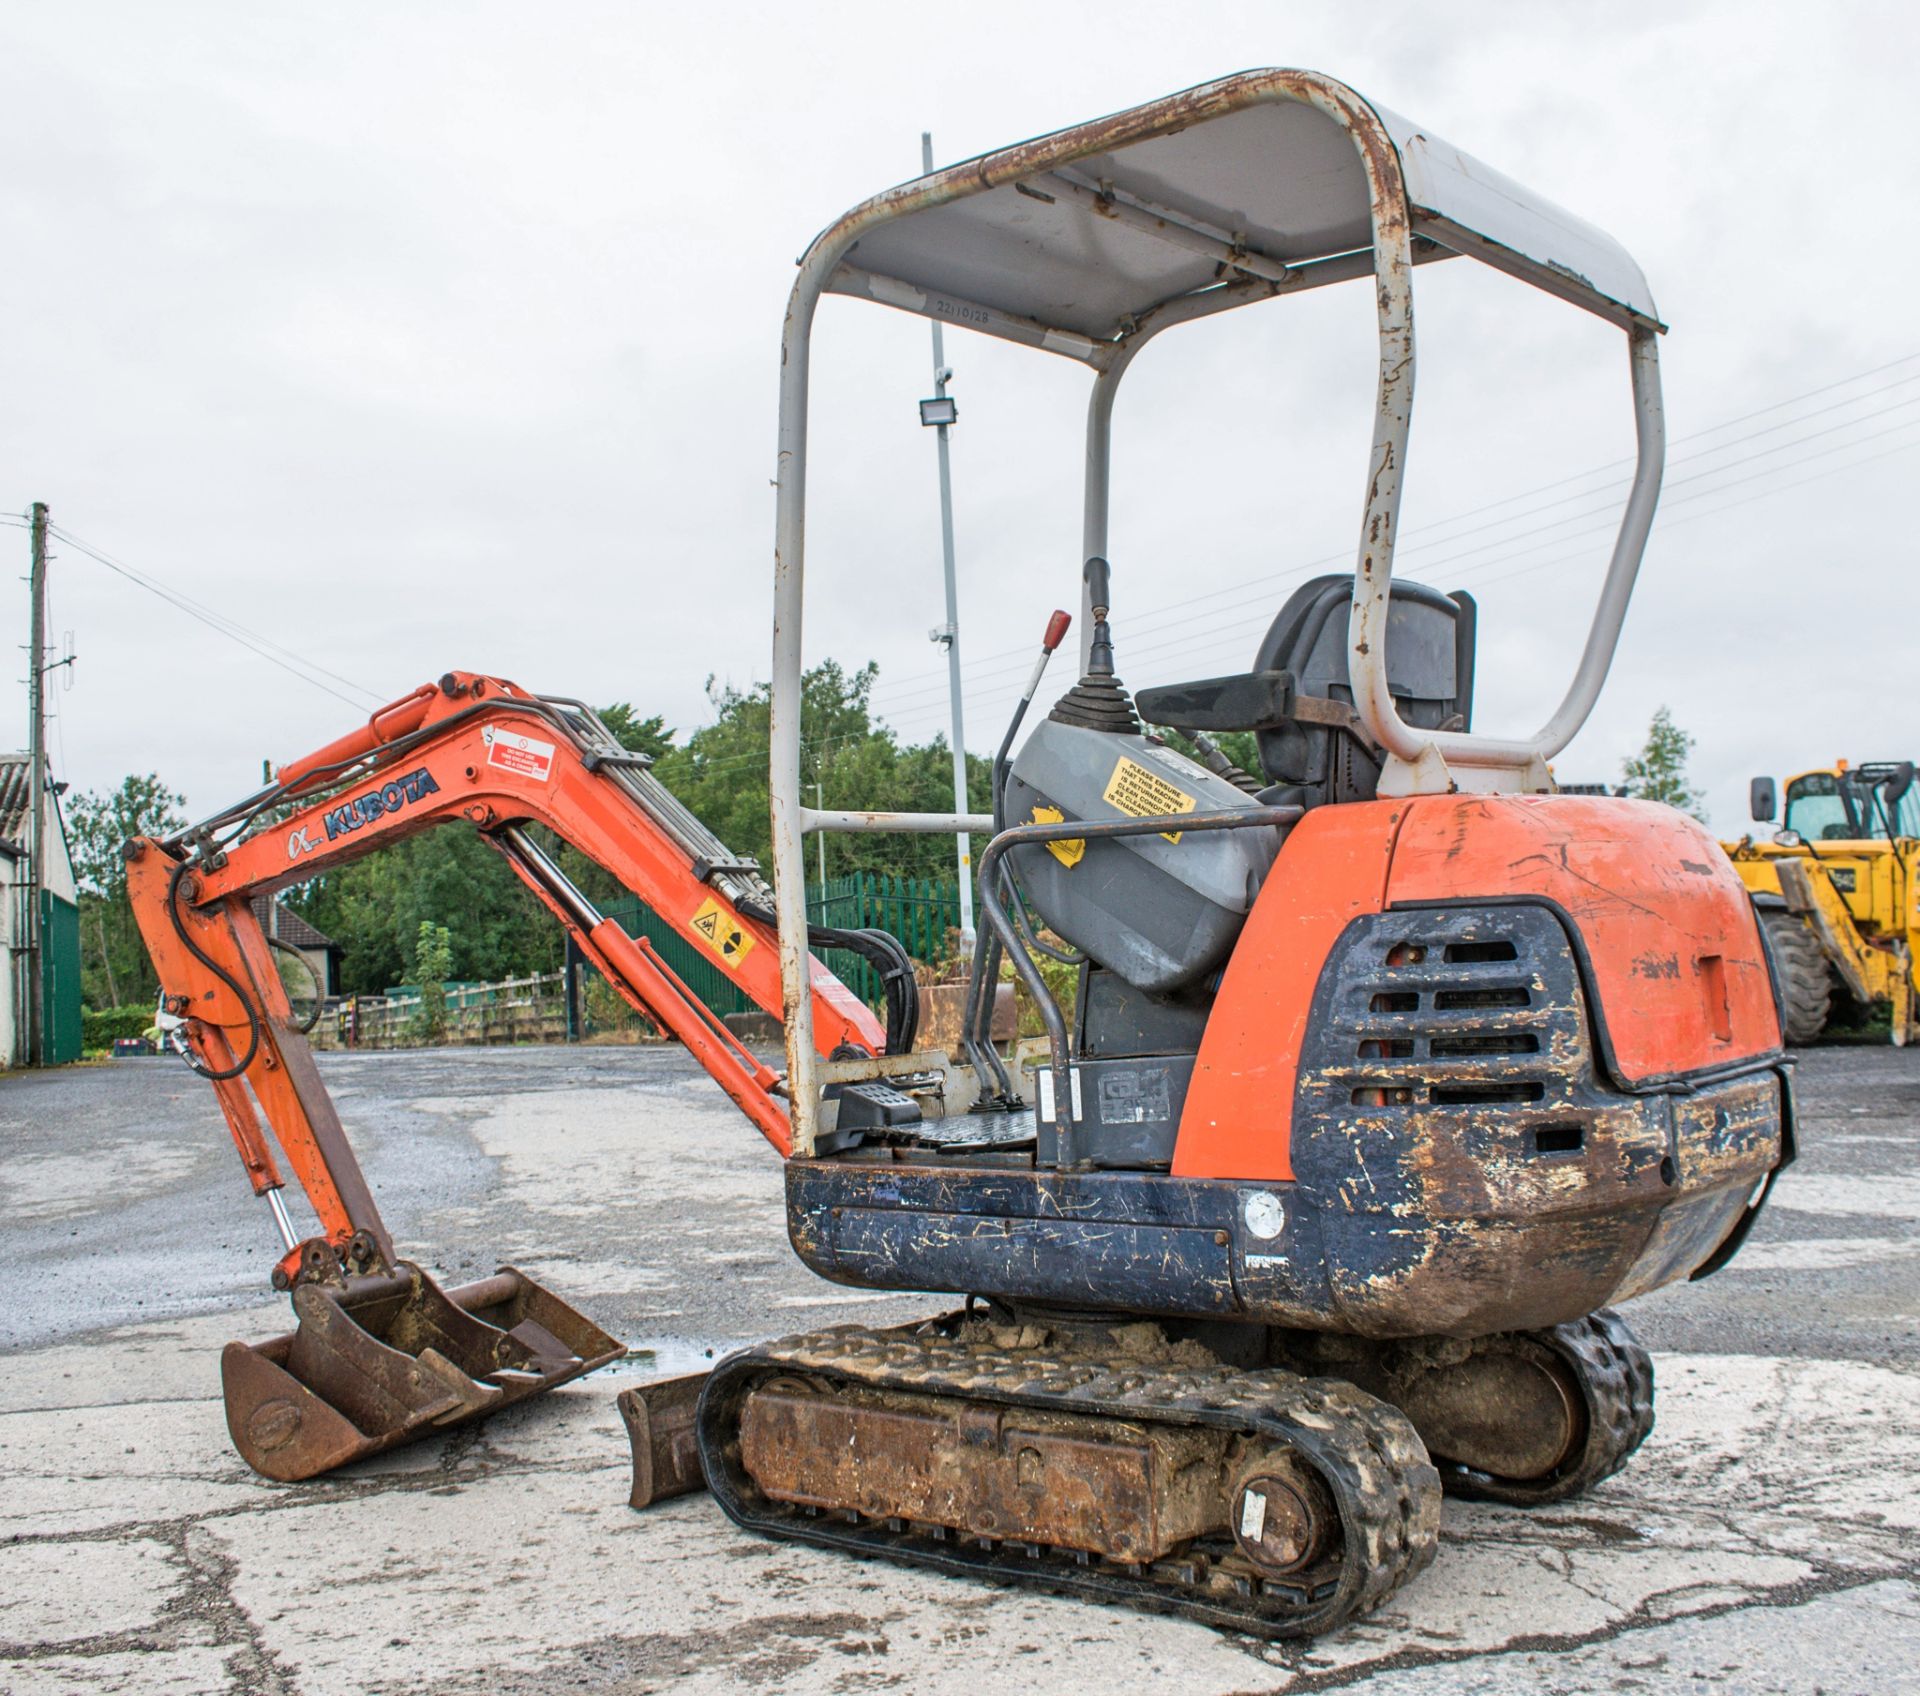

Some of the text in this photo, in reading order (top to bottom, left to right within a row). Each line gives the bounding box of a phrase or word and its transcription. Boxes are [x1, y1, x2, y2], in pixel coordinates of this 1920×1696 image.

[1108, 793, 1115, 801] IS
[1114, 789, 1124, 798] AS
[1121, 767, 1184, 809] THAT THIS MACHINE
[1129, 763, 1154, 782] PLEASE
[1155, 778, 1181, 799] ENSURE
[1129, 781, 1163, 805] RETURNED
[1164, 801, 1172, 810] IN
[323, 767, 440, 841] KUBOTA
[1117, 782, 1170, 815] CLEAN CONDITIO
